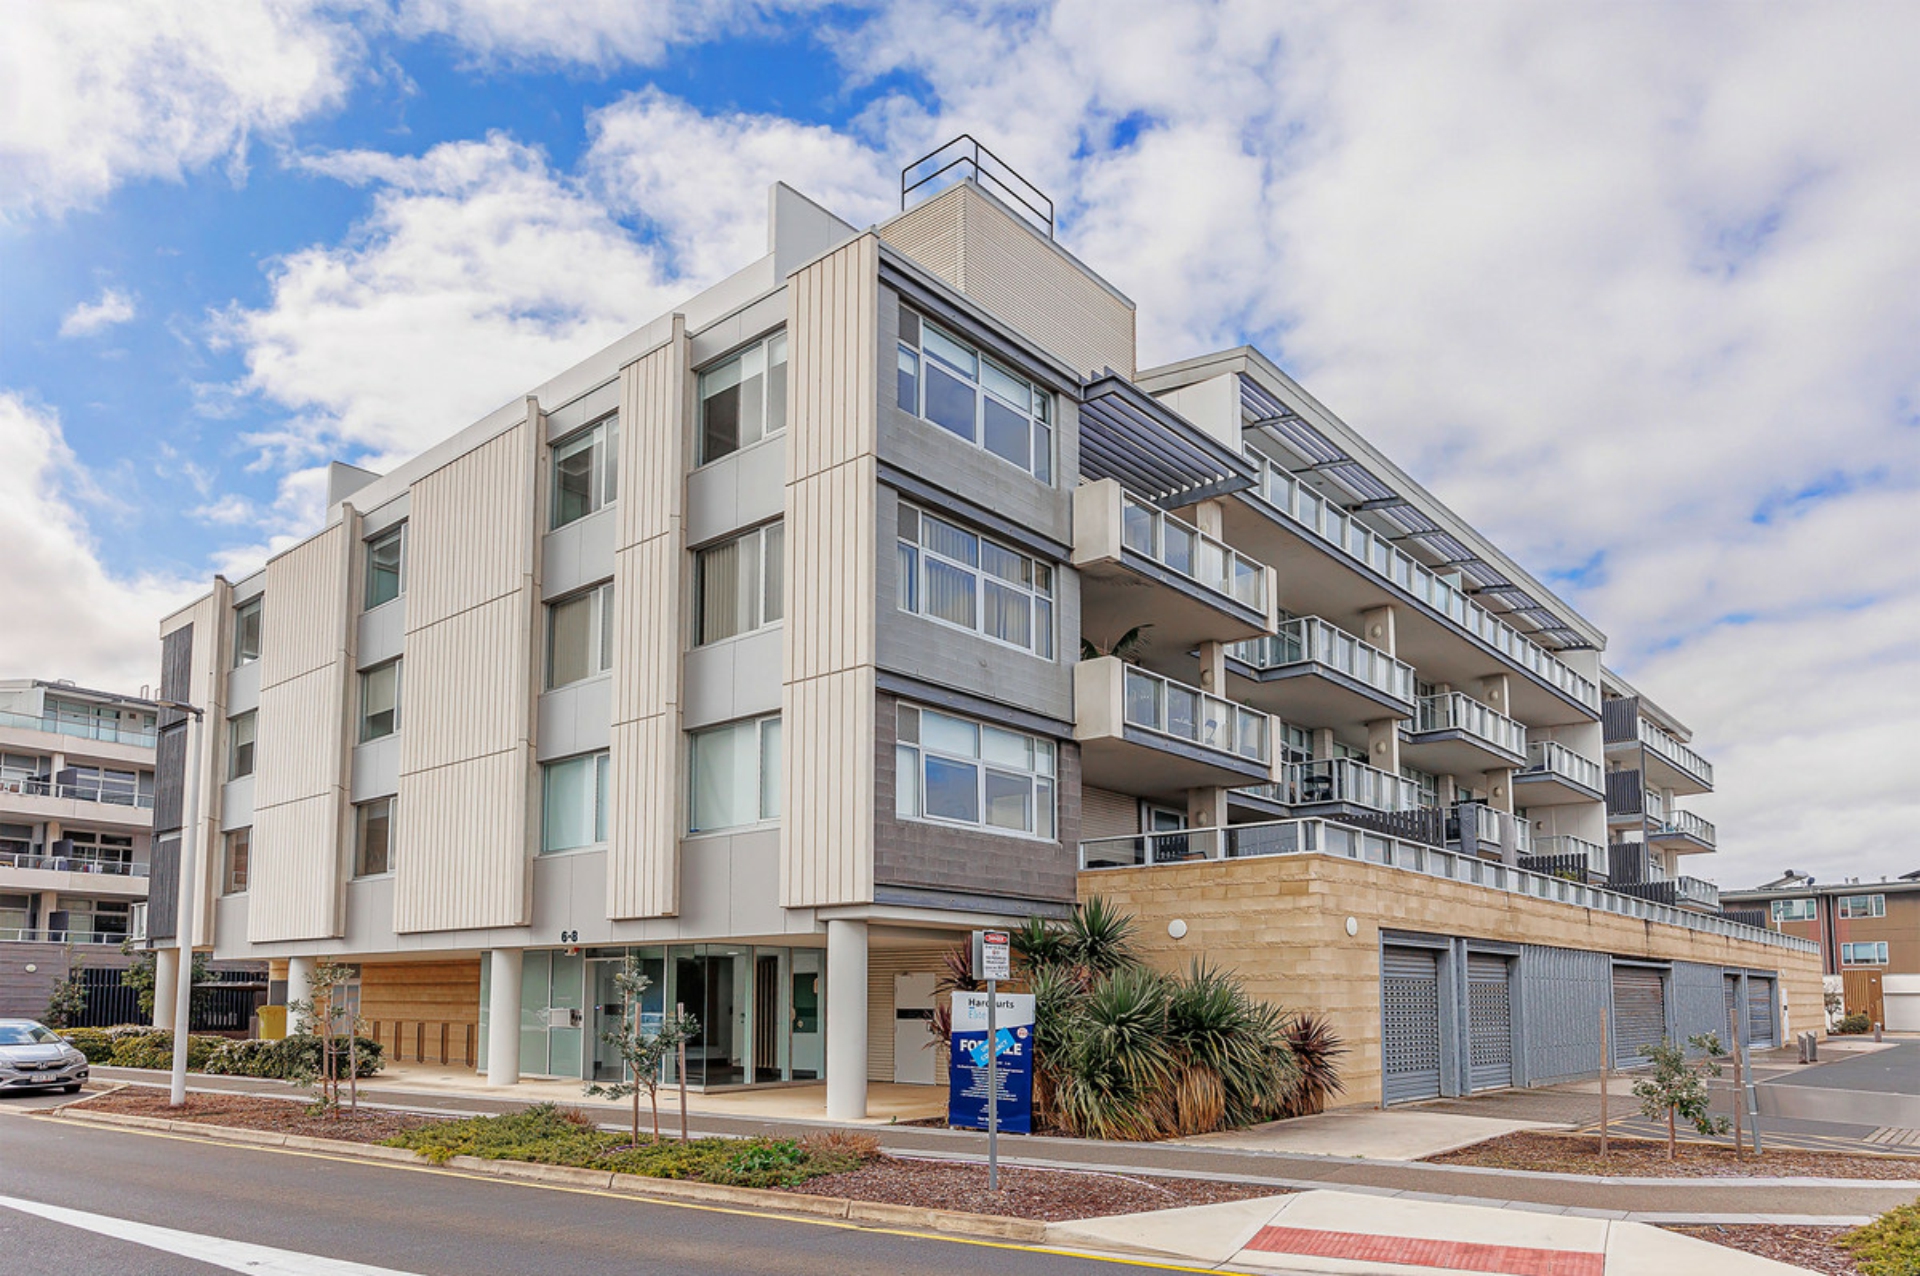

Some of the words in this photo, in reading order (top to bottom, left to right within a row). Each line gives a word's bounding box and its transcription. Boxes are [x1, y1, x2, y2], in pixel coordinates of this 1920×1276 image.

[561, 929, 578, 943] 6-8
[968, 998, 1015, 1010] Harcurts
[960, 1039, 985, 1052] FO
[980, 1039, 1008, 1062] COACT
[981, 1037, 999, 1053] UNR
